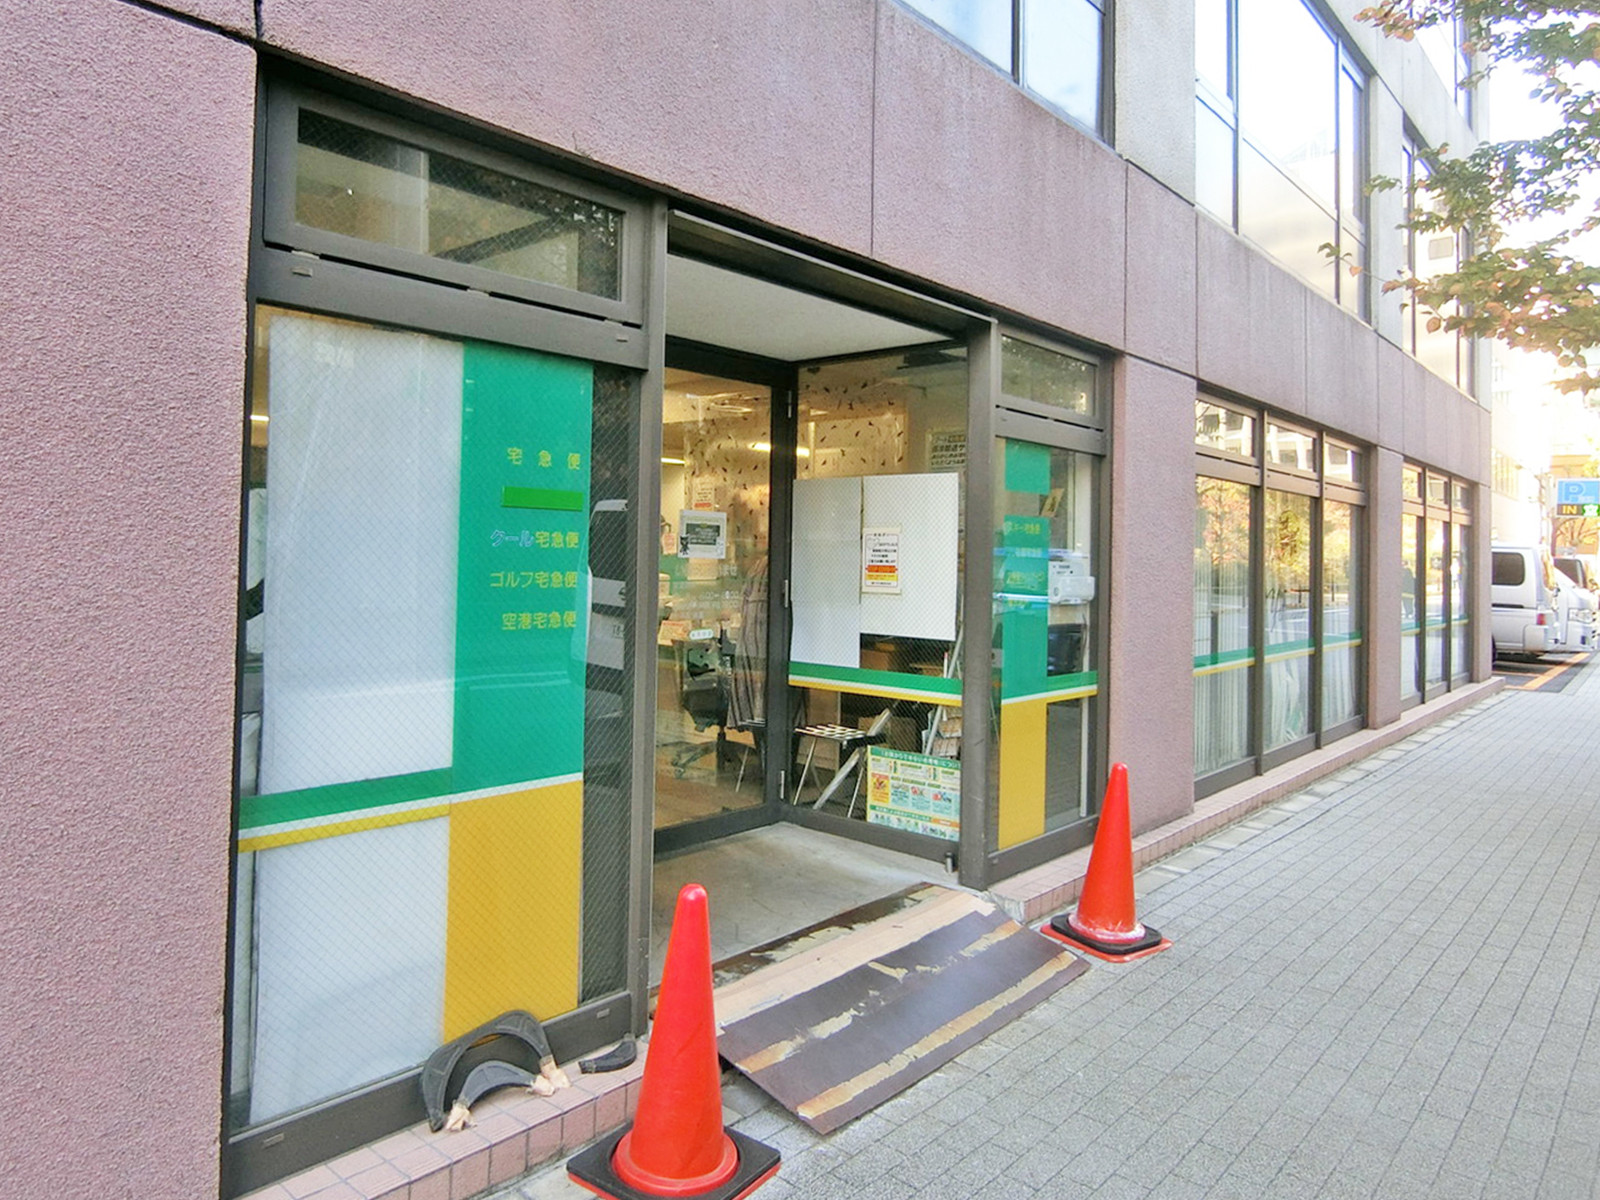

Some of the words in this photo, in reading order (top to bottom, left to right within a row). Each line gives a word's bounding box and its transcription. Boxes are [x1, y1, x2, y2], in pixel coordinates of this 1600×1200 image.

[507, 447, 581, 470] 宅急便
[1562, 482, 1586, 503] P
[1562, 505, 1577, 514] IN
[490, 529, 580, 549] クール宅急便
[490, 571, 579, 589] ゴルフ宅急便
[502, 610, 577, 630] 空港宅急便
